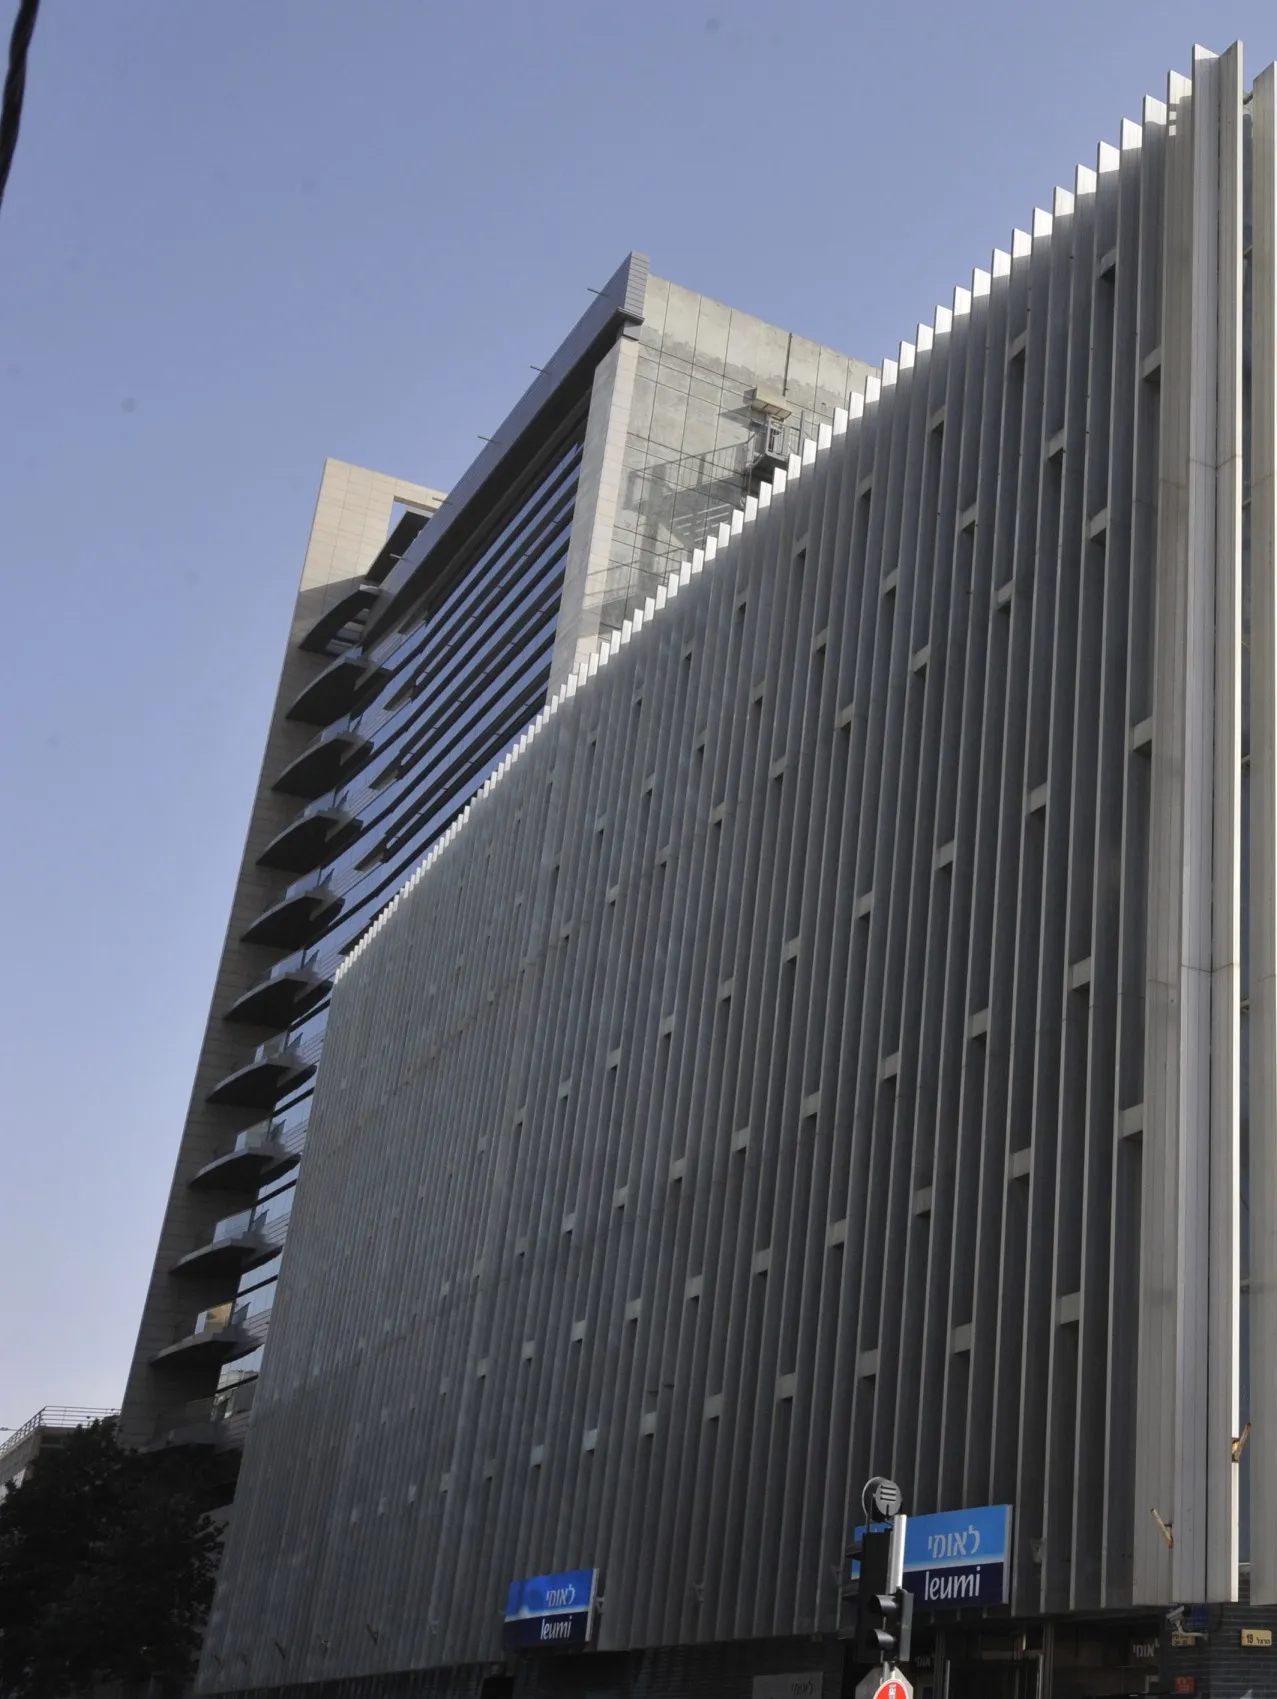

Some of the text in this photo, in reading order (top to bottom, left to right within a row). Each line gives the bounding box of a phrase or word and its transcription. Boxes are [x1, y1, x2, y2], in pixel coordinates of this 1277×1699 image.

[928, 1525, 981, 1559] לאומי
[545, 1583, 576, 1608] לאומי
[924, 1566, 981, 1601] leumi
[540, 1615, 572, 1640] leumi
